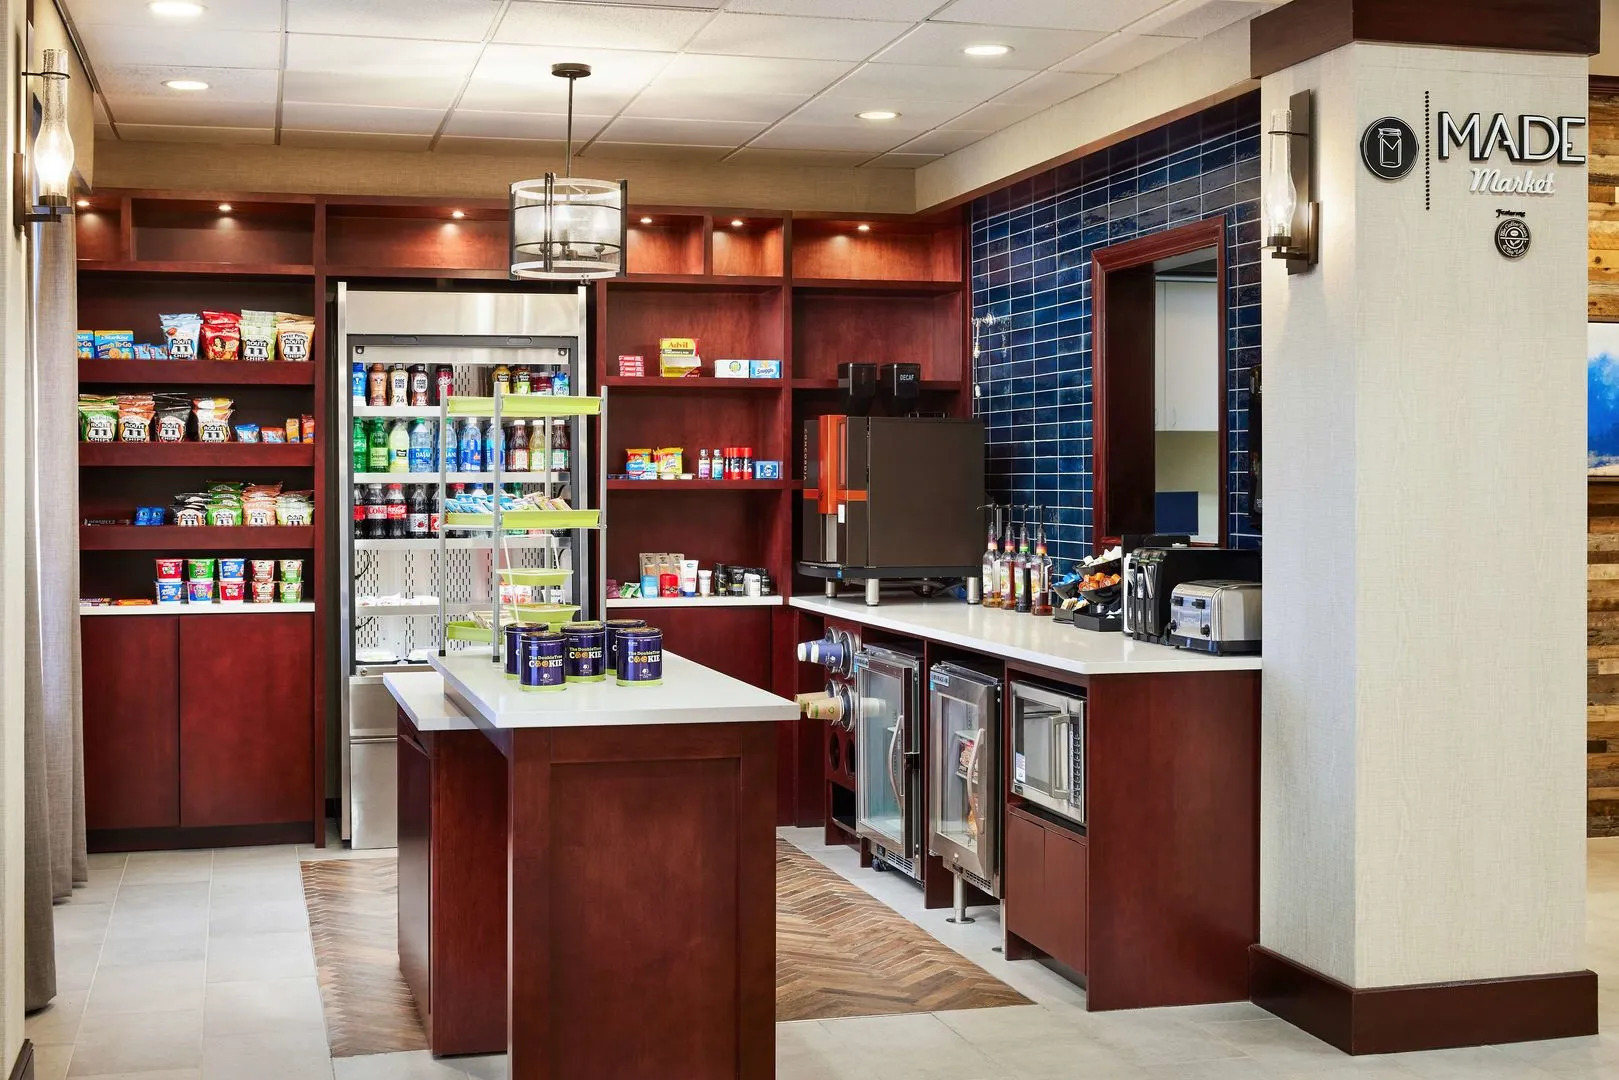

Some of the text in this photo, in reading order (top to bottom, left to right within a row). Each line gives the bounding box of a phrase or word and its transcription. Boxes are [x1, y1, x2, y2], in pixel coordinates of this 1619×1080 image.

[1438, 111, 1586, 164] MADE
[1469, 167, 1556, 194] Market
[569, 651, 602, 659] COOKIE
[628, 655, 661, 663] COOKIE
[529, 659, 563, 668] COOKIE
